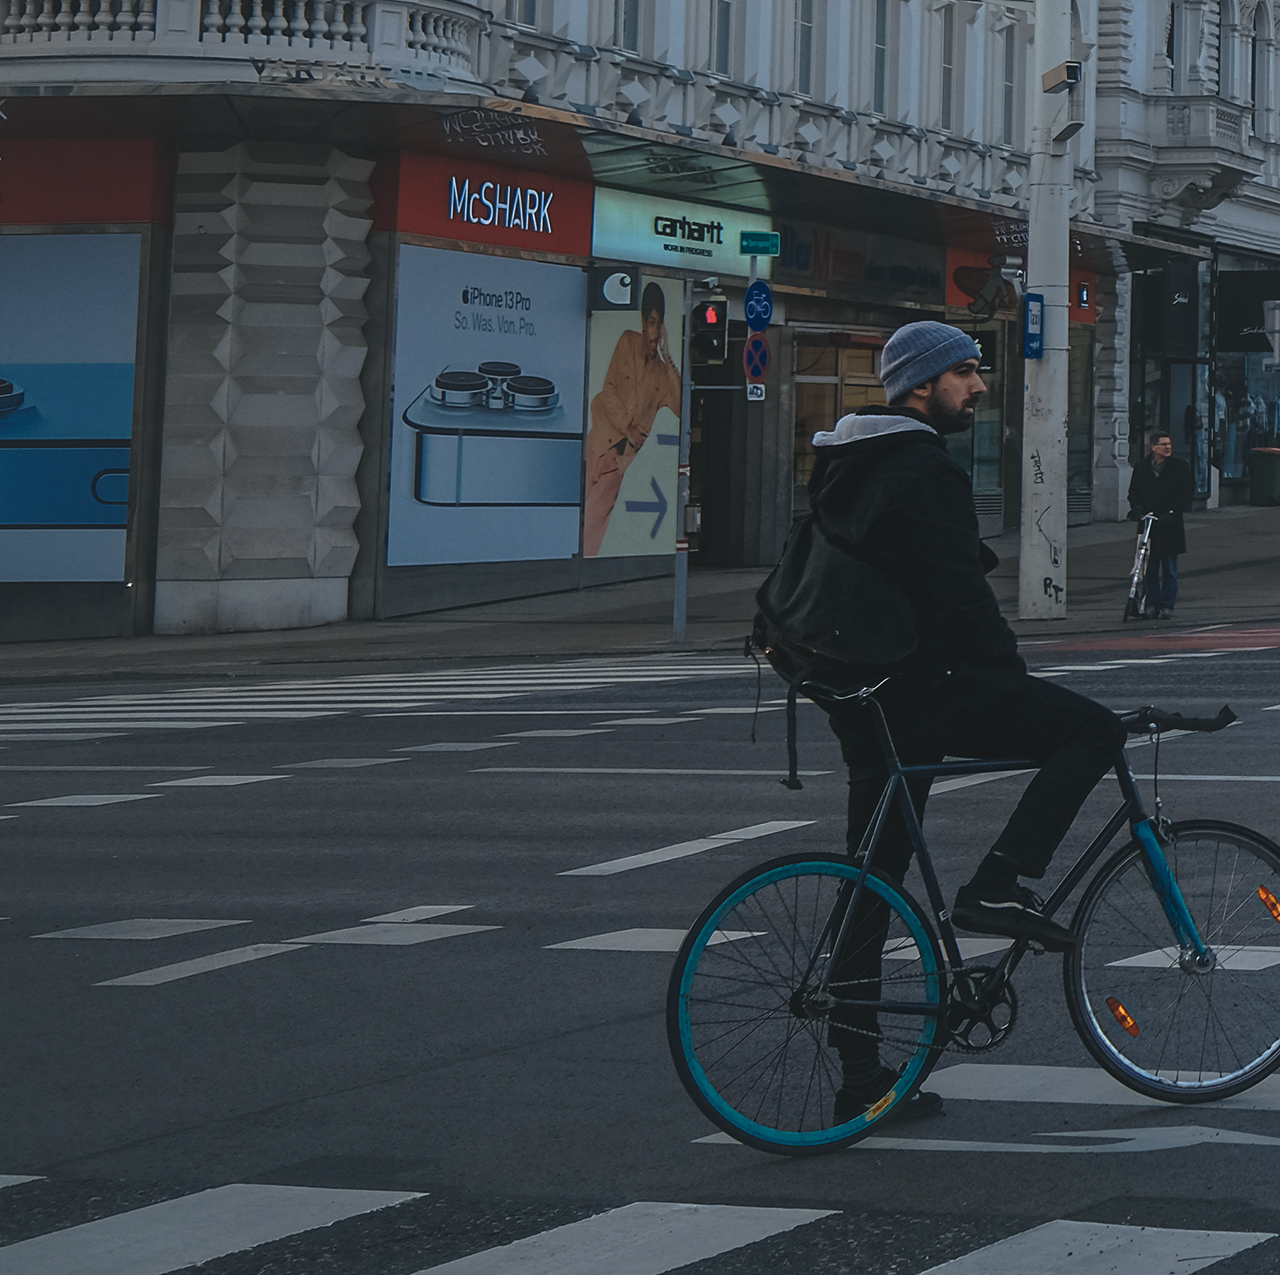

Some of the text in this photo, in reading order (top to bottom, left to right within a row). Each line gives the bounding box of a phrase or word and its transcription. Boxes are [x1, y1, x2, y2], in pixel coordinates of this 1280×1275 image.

[449, 175, 554, 234] McSHARK
[654, 215, 724, 245] carhartt
[663, 244, 679, 252] WORK
[685, 247, 713, 257] PROGRESS
[469, 286, 531, 311] iPhone 13 Pro
[454, 310, 537, 336] So. Was. Von. Pro.
